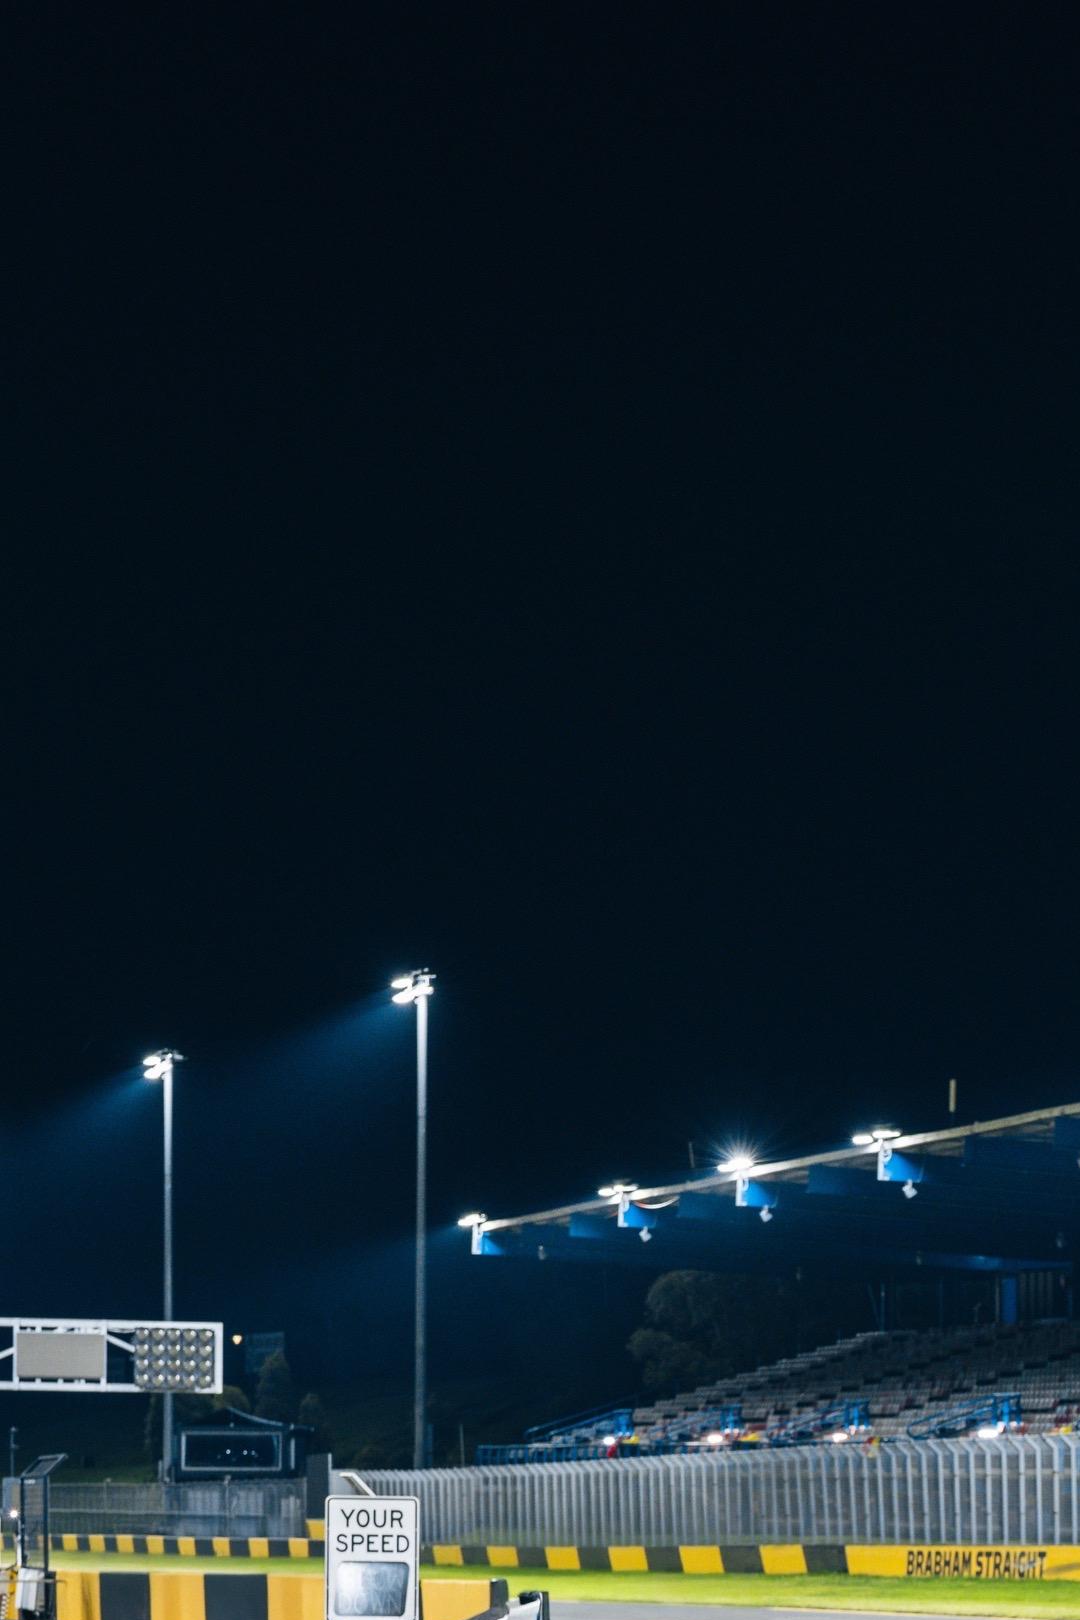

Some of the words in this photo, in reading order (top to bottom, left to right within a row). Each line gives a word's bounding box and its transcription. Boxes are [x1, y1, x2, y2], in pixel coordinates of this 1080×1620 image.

[341, 1509, 403, 1528] YOUR
[336, 1534, 410, 1553] SPEED
[906, 1551, 972, 1576] BRABHAM
[975, 1551, 1047, 1579] STRAIGHT
